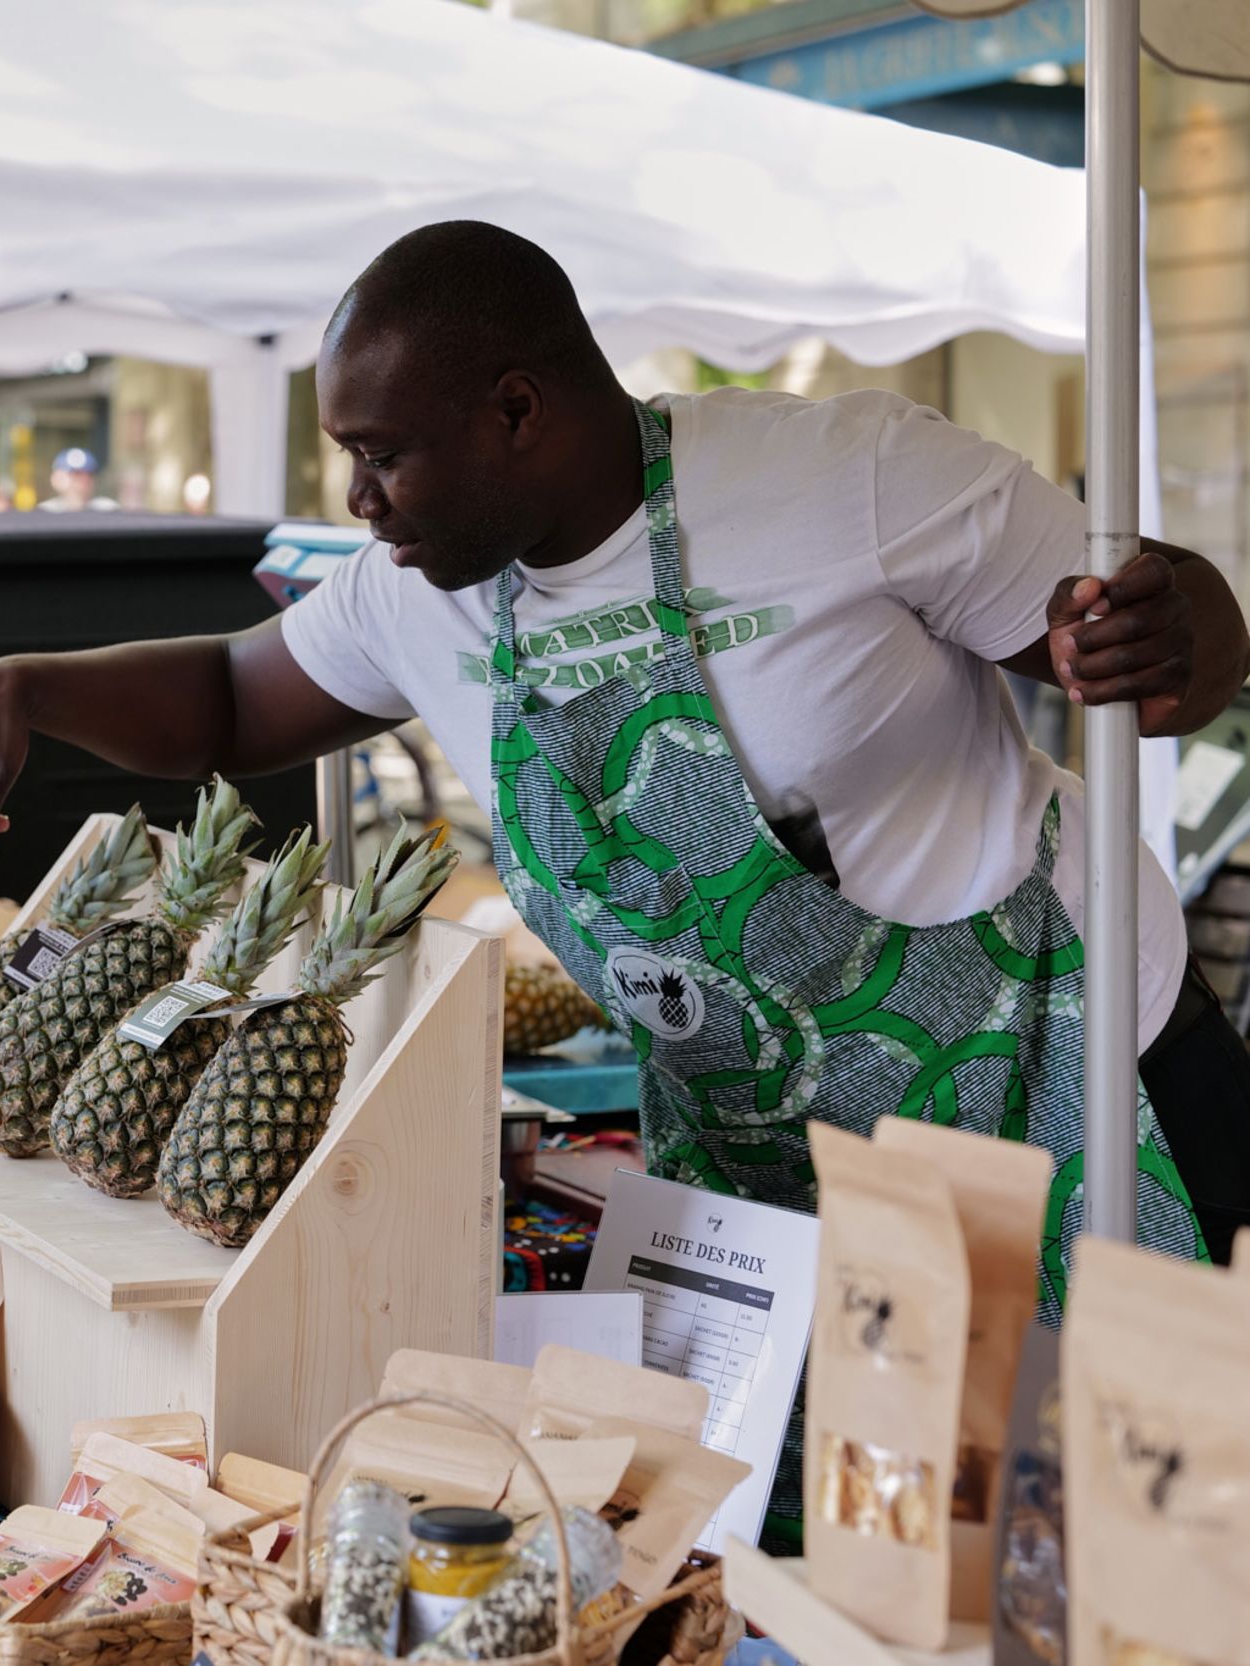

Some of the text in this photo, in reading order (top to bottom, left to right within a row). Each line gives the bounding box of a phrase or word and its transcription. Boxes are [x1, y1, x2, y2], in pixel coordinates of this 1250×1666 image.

[477, 614, 759, 688] LOAED
[650, 1231, 766, 1274] LISTE DES PRIX
